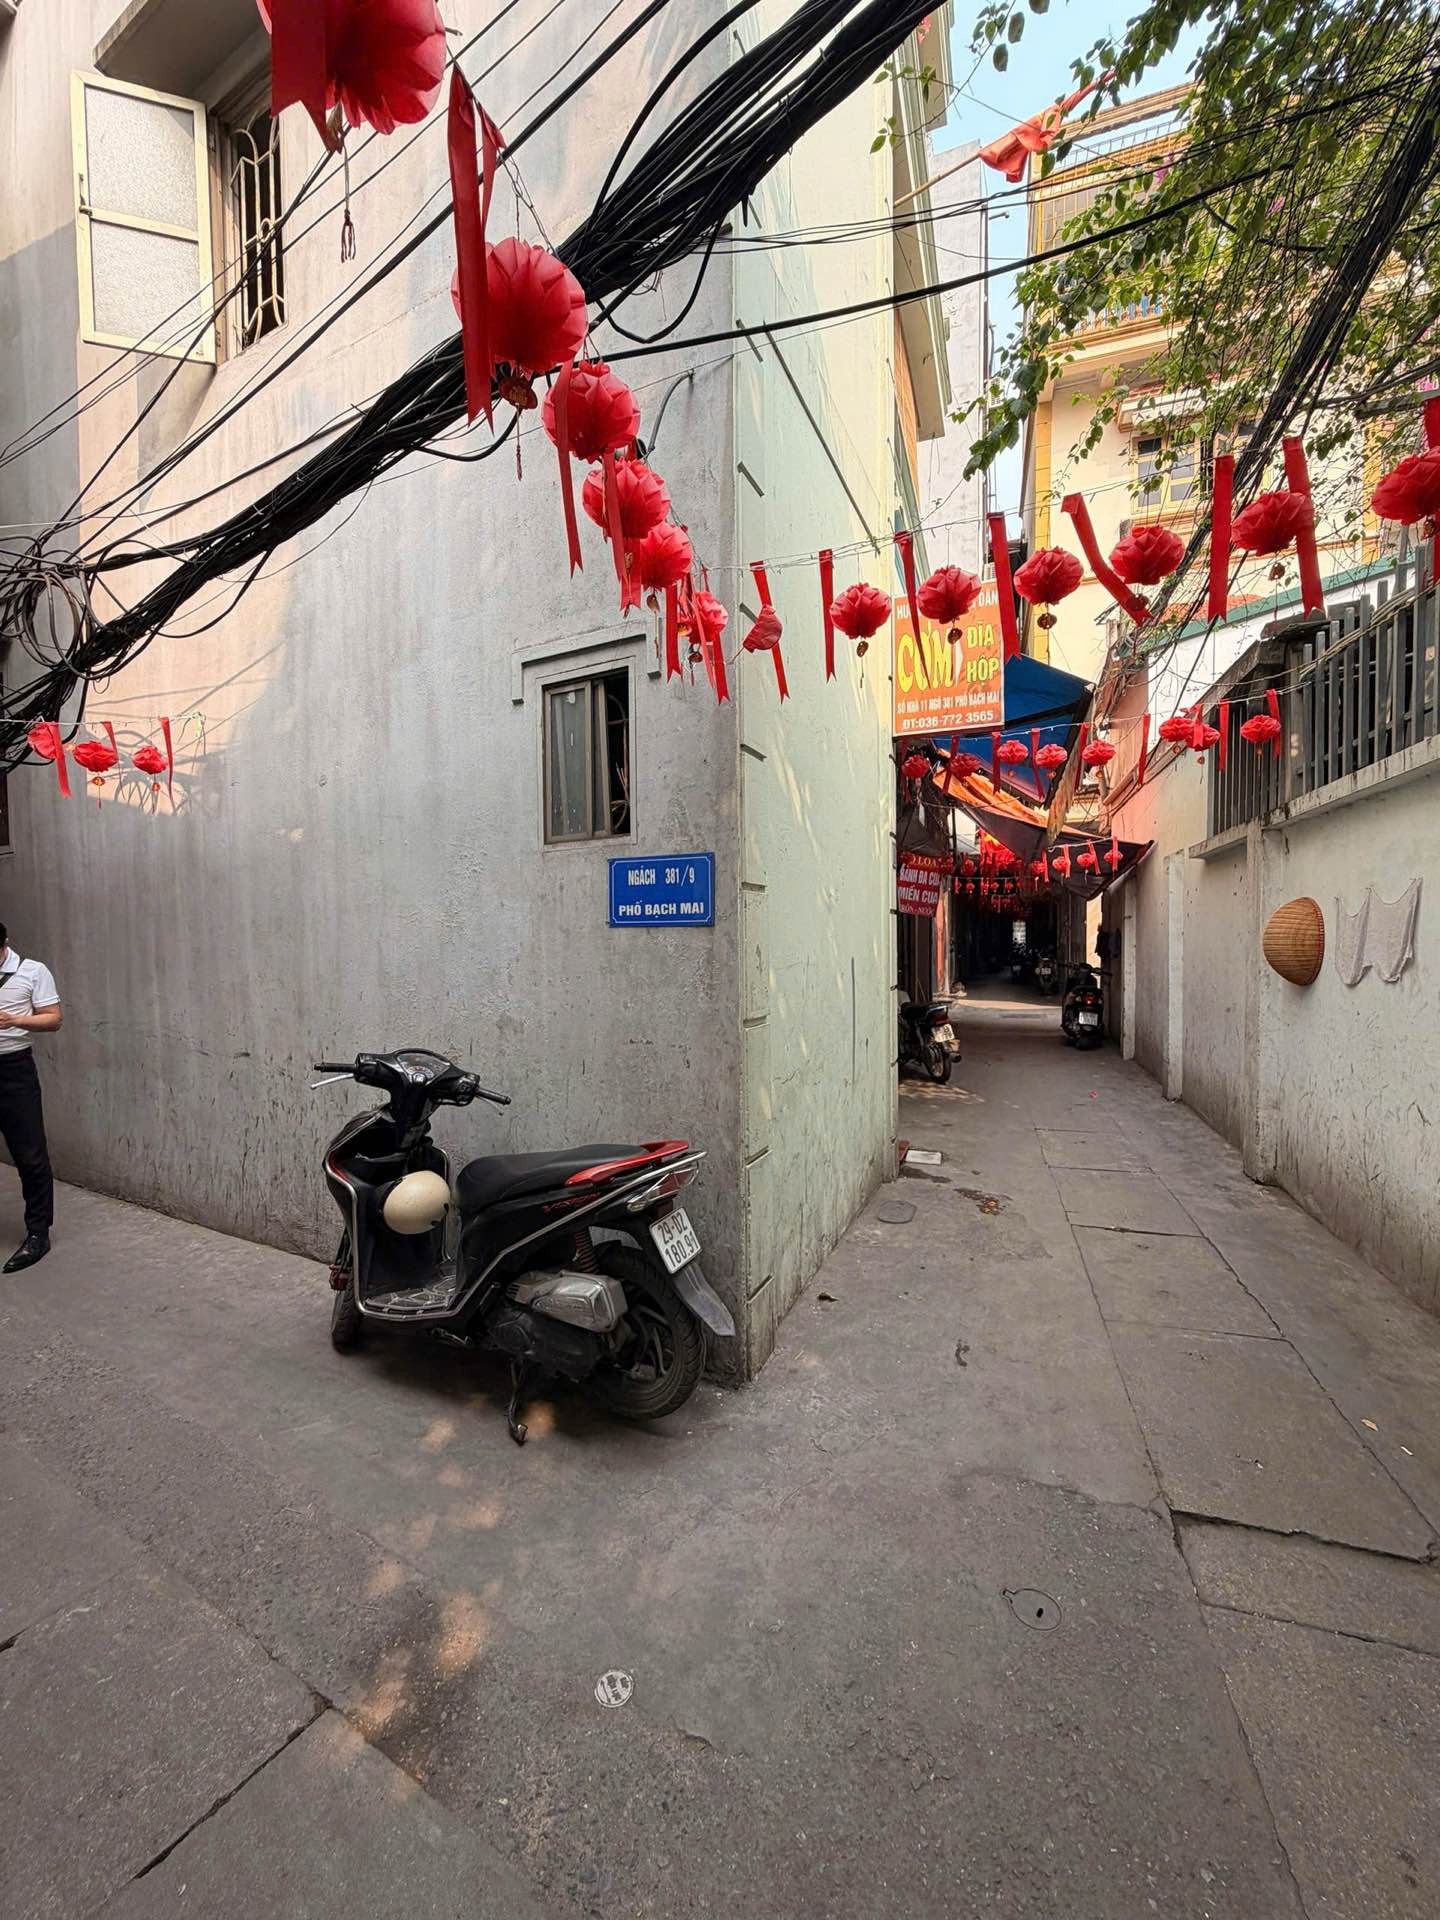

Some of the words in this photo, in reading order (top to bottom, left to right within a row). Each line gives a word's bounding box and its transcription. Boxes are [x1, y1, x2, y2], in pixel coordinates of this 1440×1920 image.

[897, 620, 954, 693] CƠM
[966, 654, 1000, 687] HỘP
[943, 696, 954, 709] 381
[966, 710, 994, 723] 3565
[627, 865, 656, 886] NGÁCH
[665, 864, 695, 887] 381/9
[618, 900, 642, 916] PHỐ
[645, 903, 677, 918] BẠCH
[680, 902, 704, 914] MAI
[665, 1231, 699, 1267] 180.91
